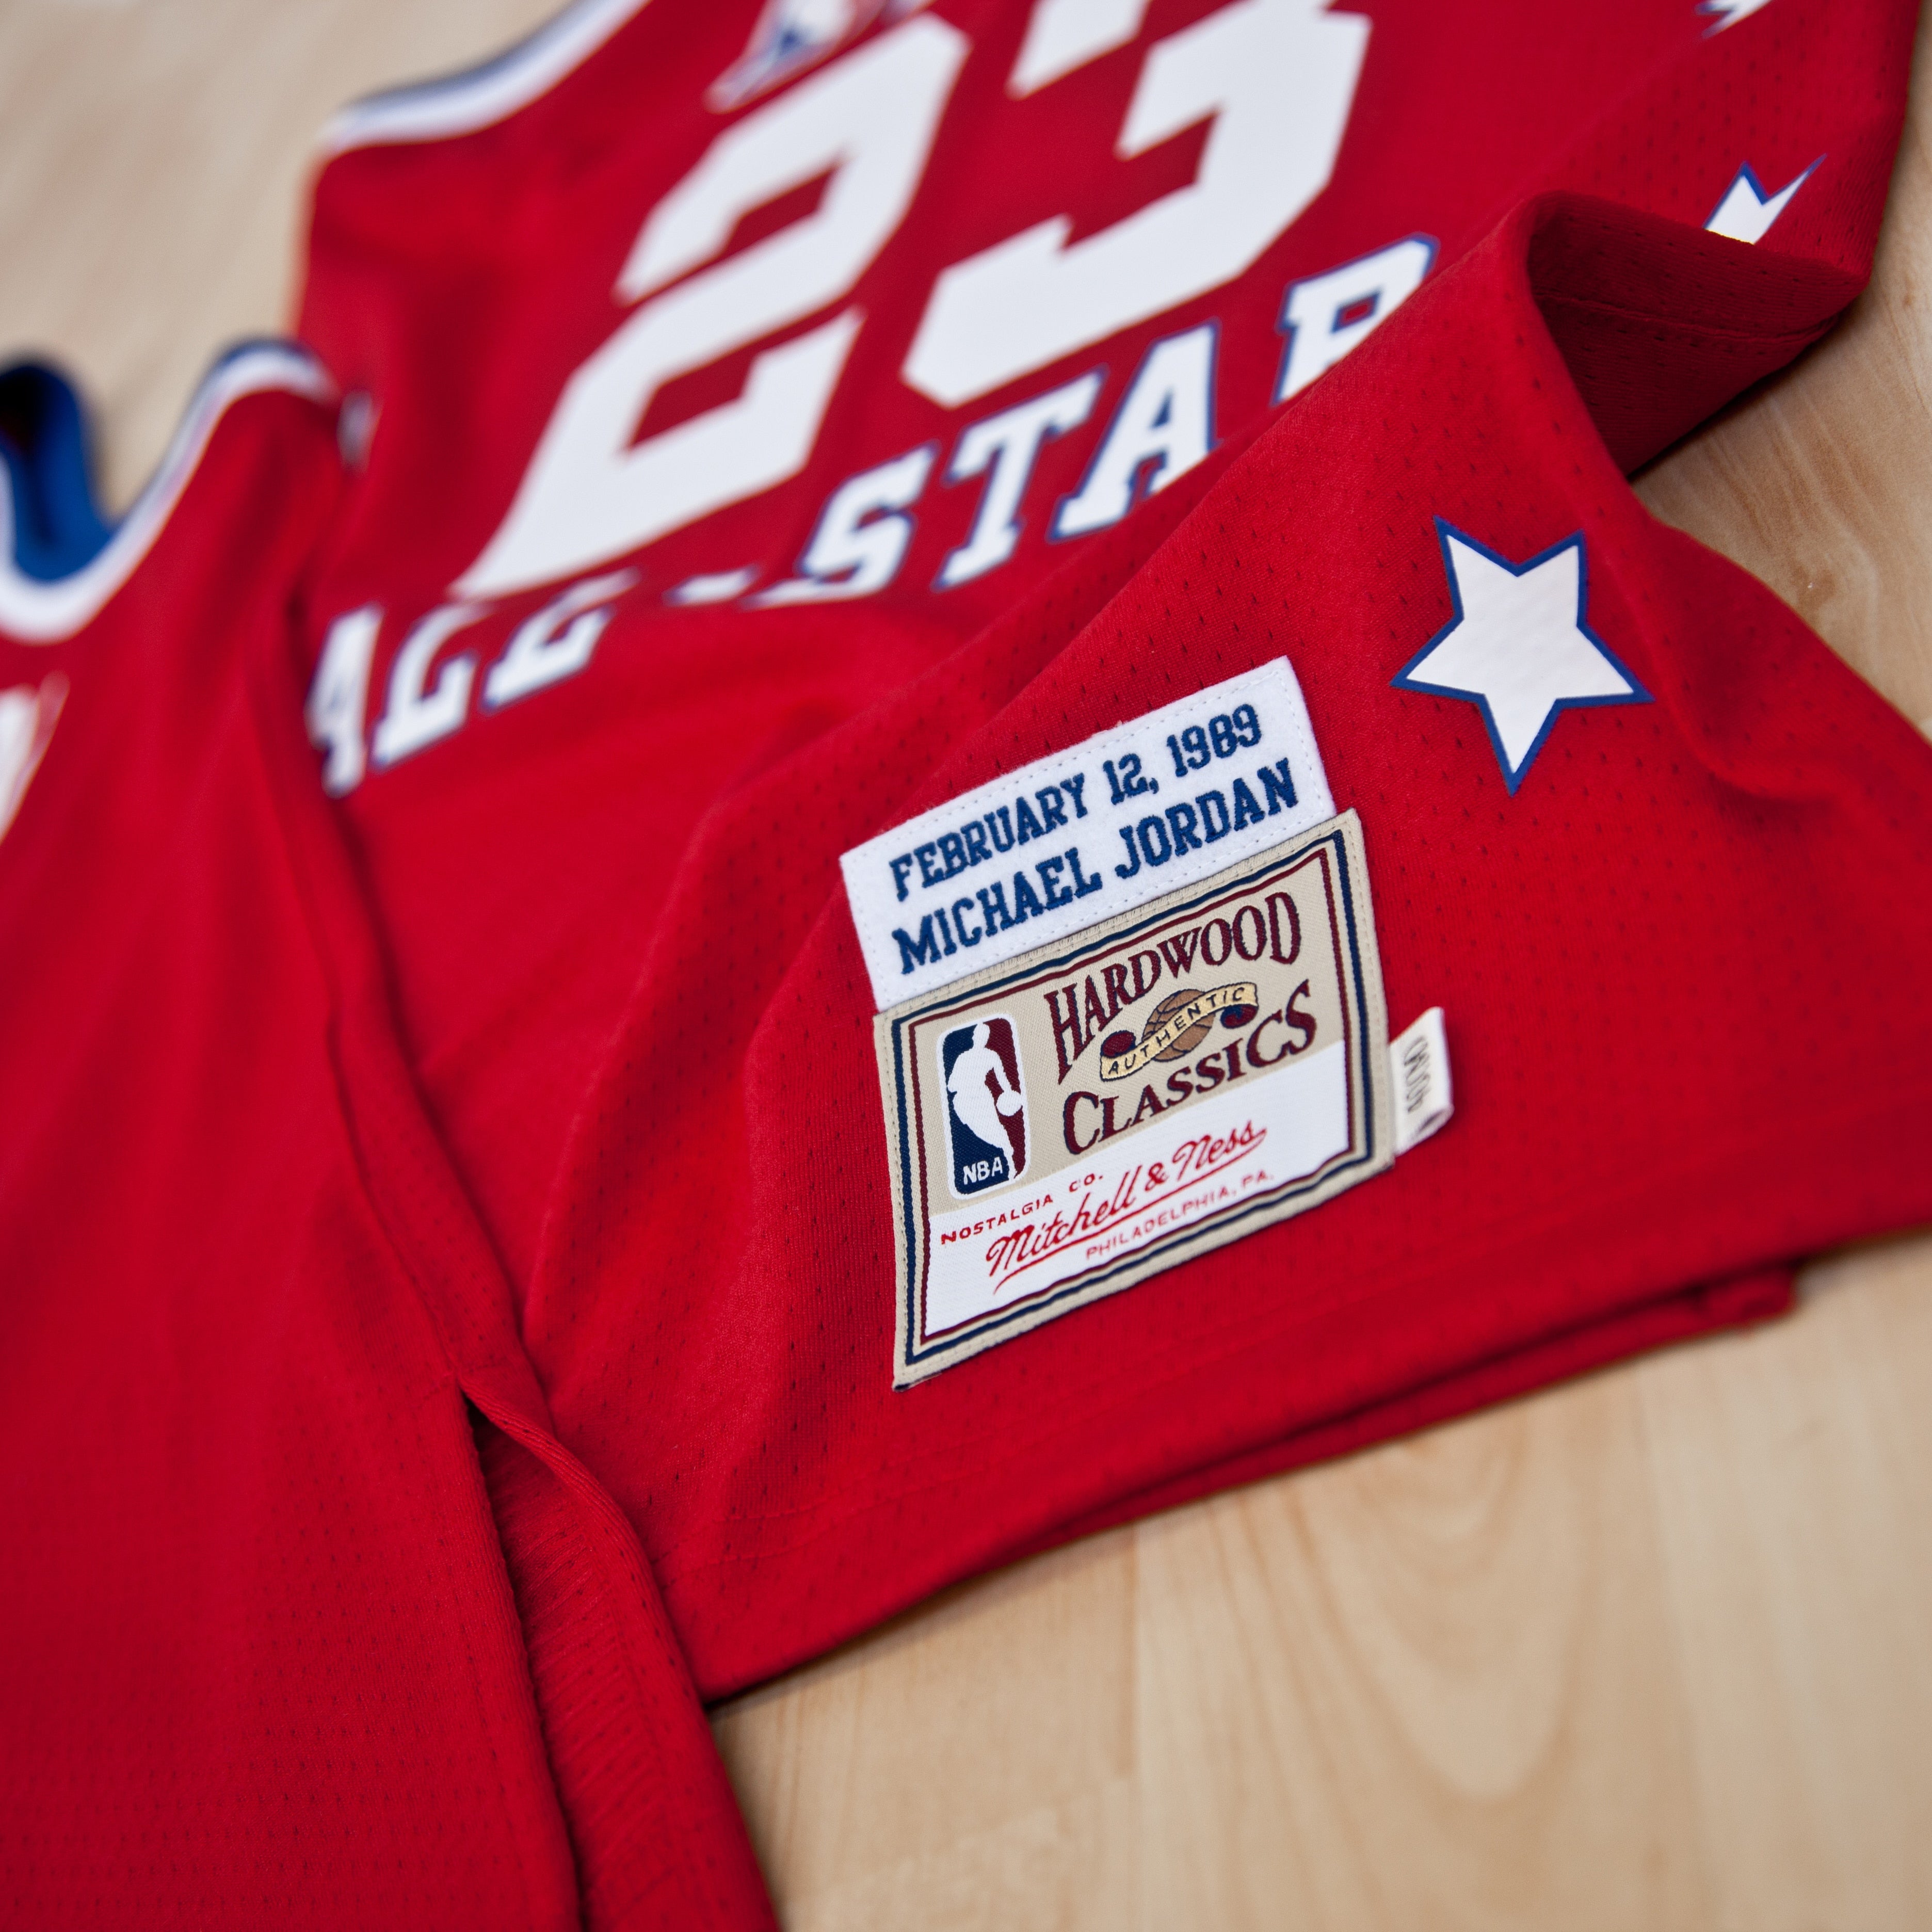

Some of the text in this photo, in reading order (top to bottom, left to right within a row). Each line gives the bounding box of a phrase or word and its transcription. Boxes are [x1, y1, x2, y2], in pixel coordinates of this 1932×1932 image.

[448, 0, 1373, 600] 23
[889, 702, 1261, 901] FEBRUARY 12, 1989
[891, 758, 1300, 975] MICHAEL JORDAN
[1043, 892, 1302, 1085] HARDWOOD
[1062, 979, 1317, 1155] CLASSICS
[1108, 986, 1245, 1075] AUTHENTIC
[940, 1173, 1103, 1245] NOSTALGIA CO.
[963, 1157, 1004, 1185] NBA
[986, 1119, 1267, 1277] Mitchell & Ness
[1086, 1170, 1275, 1260] PHILADELPHIA, PA.
